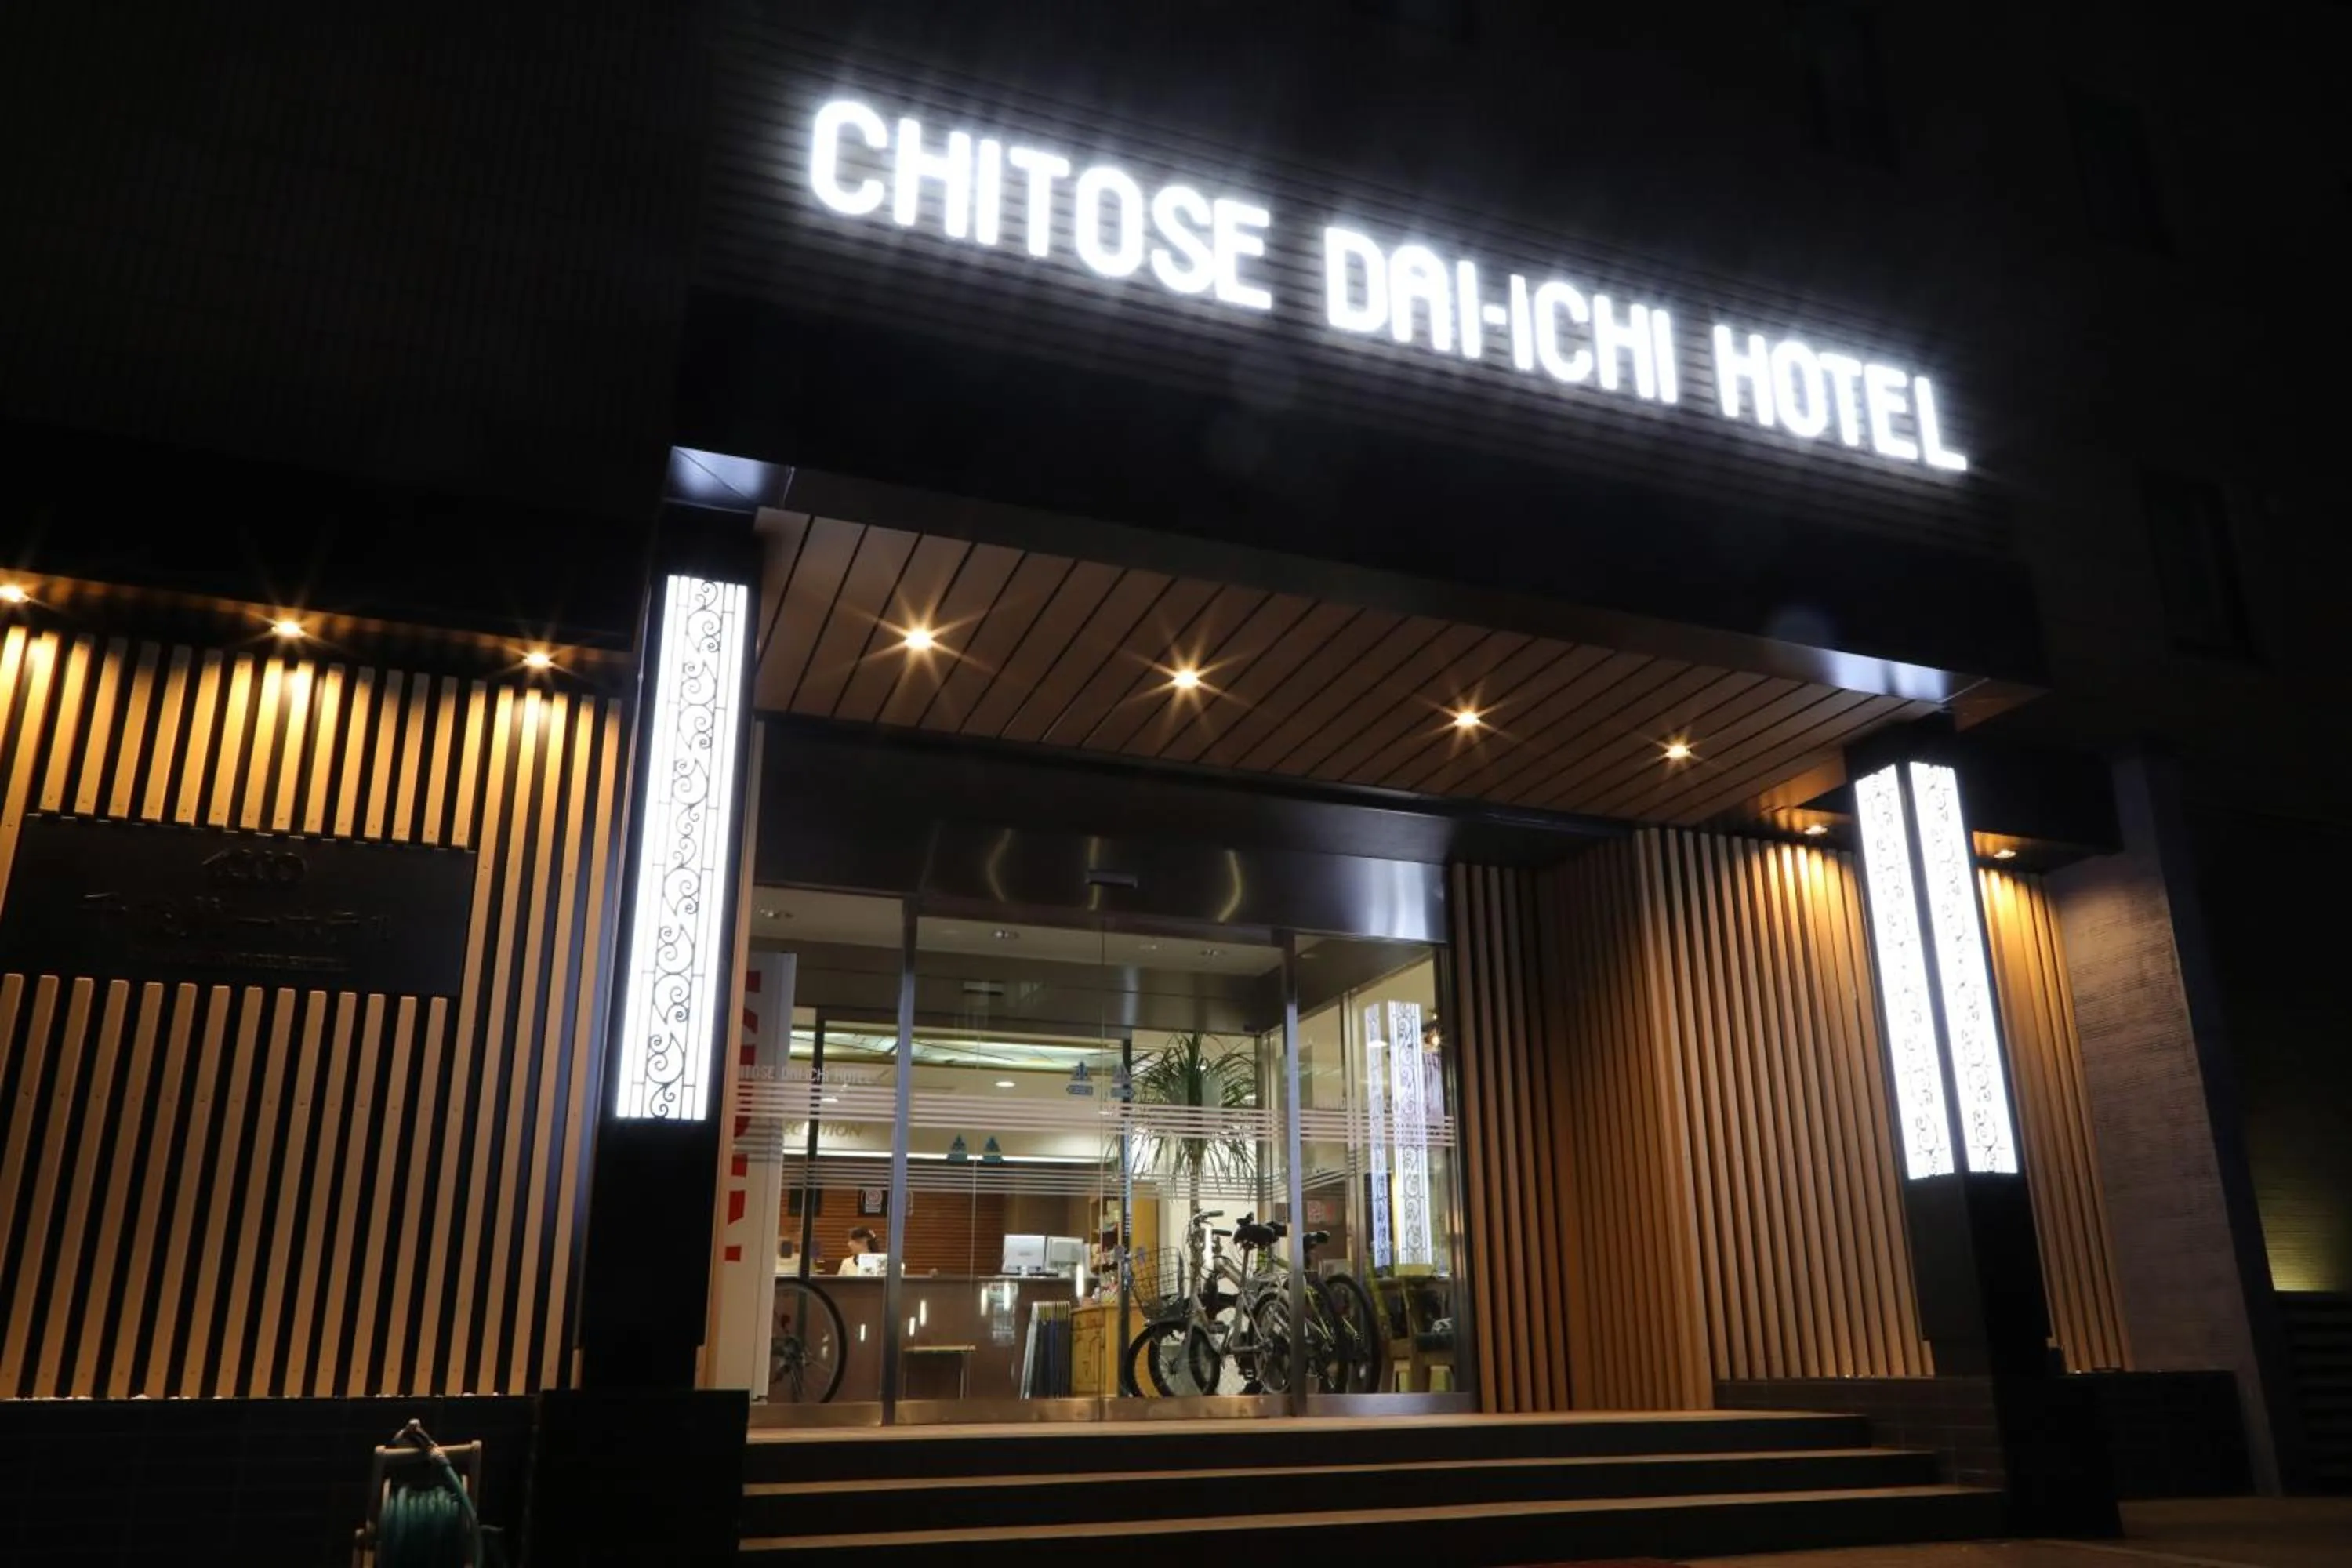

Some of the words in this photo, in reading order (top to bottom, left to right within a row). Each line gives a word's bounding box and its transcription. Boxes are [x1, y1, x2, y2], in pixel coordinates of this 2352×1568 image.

[808, 100, 1272, 309] CHITOSE
[1324, 227, 1678, 403] DAI-ICHI
[1713, 325, 1966, 470] HOTEL
